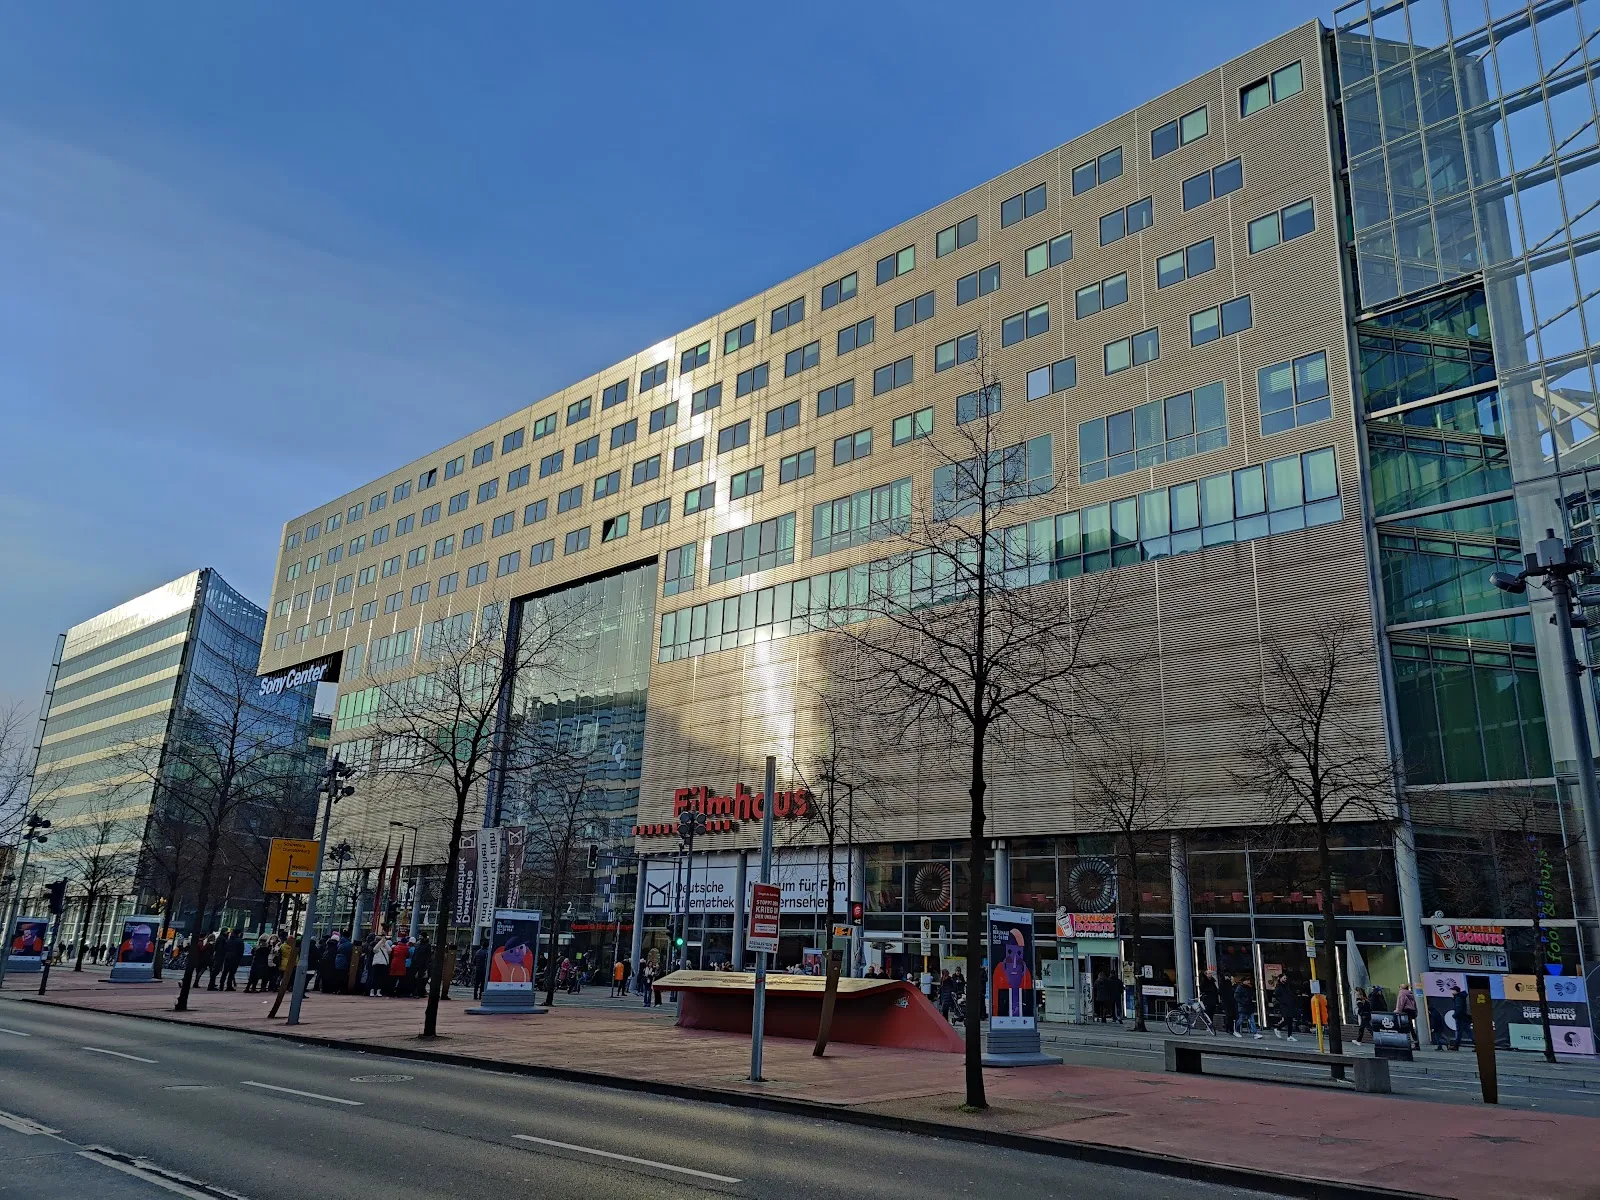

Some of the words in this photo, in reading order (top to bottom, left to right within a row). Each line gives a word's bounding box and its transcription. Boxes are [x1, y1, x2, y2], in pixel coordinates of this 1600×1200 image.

[259, 676, 287, 696] Sony
[286, 664, 327, 688] Center
[799, 879, 817, 891] für
[755, 906, 774, 914] KRIEG
[1075, 922, 1116, 932] DONUTS
[1457, 932, 1505, 945] DONUTS
[1469, 956, 1481, 964] DB
[1498, 956, 1505, 965] P
[1523, 1012, 1577, 1020] DIFFRENTLY
